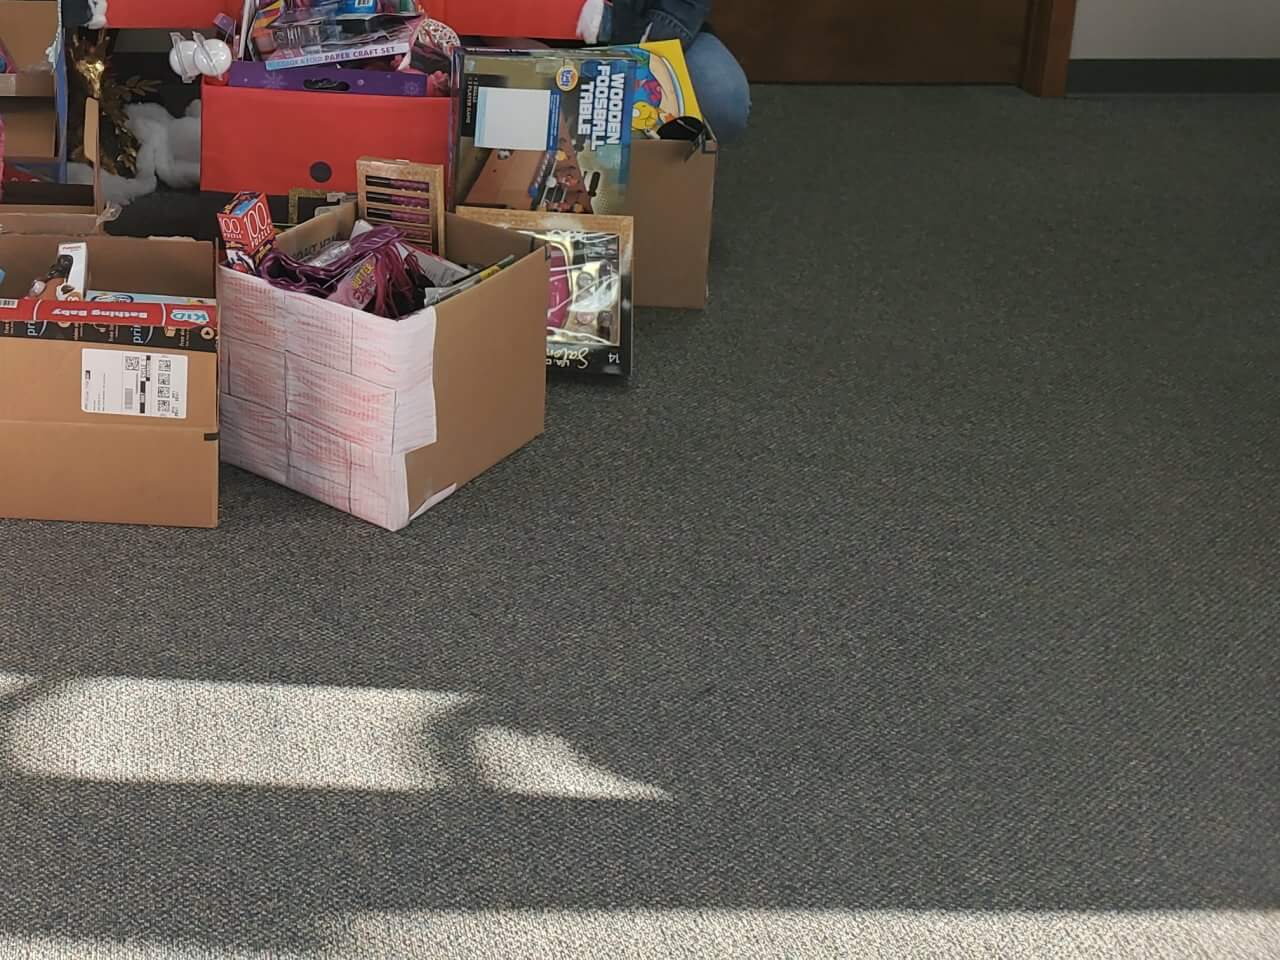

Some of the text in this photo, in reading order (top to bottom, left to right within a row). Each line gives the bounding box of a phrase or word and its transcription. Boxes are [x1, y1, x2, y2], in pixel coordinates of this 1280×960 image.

[324, 51, 352, 61] PAPER
[352, 48, 378, 58] CRAFT
[380, 46, 396, 55] SET
[577, 81, 595, 135] TABLE
[591, 65, 611, 151] FOOSBALL
[606, 73, 625, 145] WOODEN
[218, 217, 241, 234] 100
[243, 202, 267, 243] 100
[51, 308, 208, 321] KID Bathing Baby
[608, 353, 621, 364] 14
